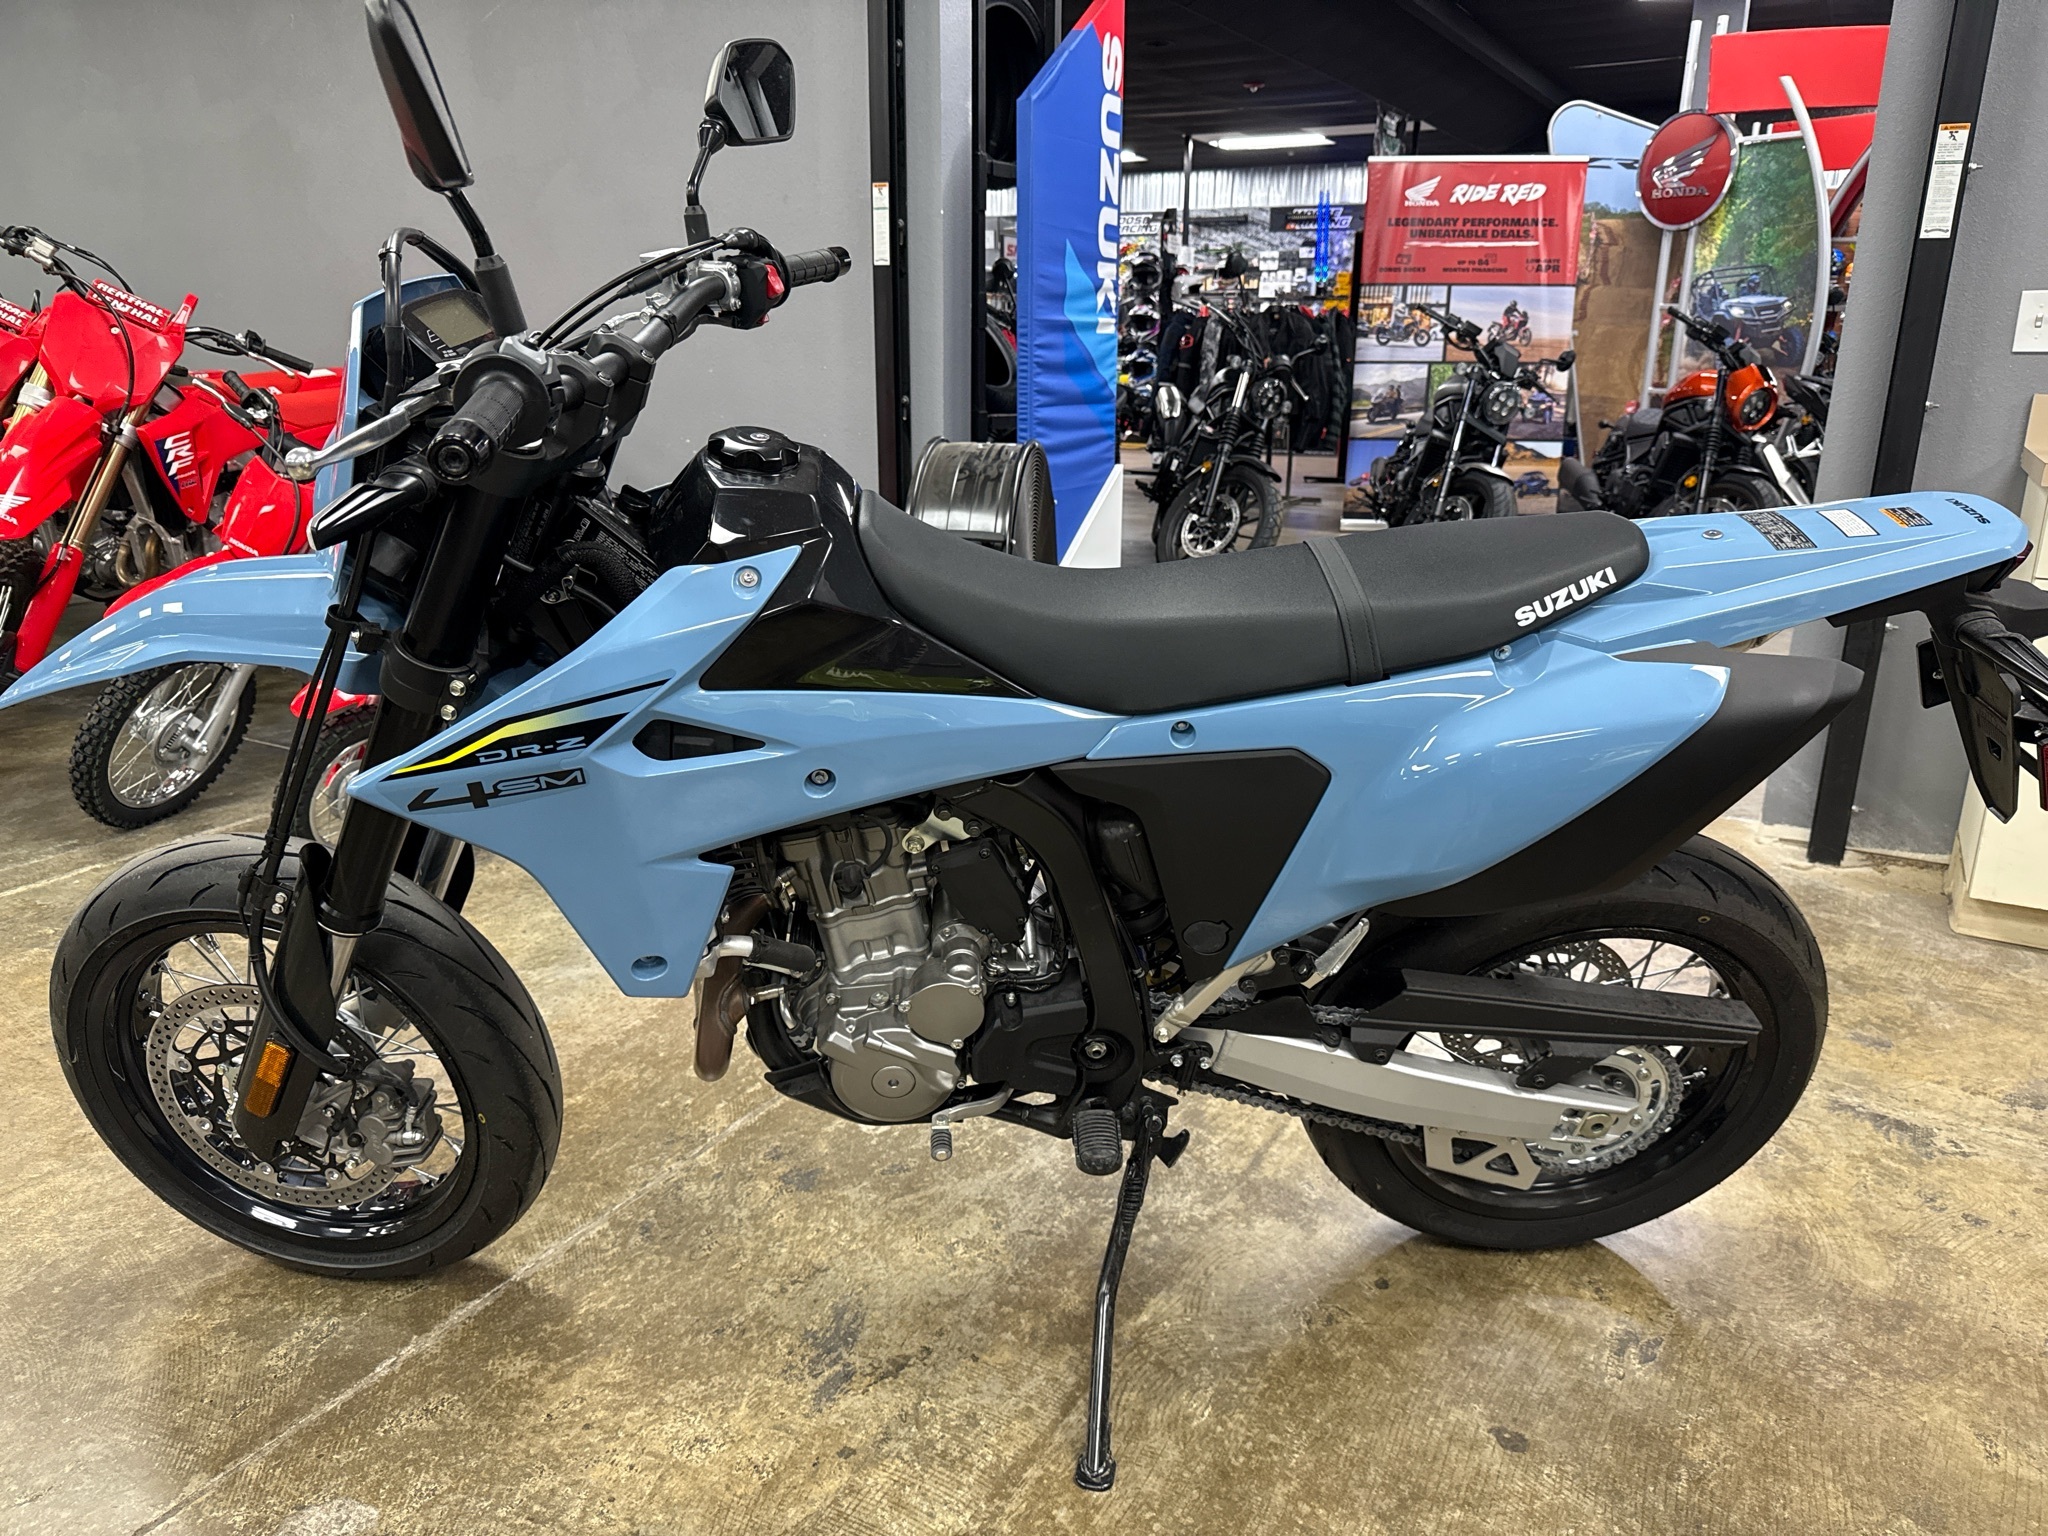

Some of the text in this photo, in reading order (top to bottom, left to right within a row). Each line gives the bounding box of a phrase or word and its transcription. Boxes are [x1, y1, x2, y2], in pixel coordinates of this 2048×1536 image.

[1096, 31, 1123, 335] SUZUKI
[1449, 182, 1547, 206] RIDE RED
[1651, 186, 1710, 199] HONDA
[1404, 199, 1440, 207] HONDA
[1387, 217, 1559, 227] LEGENDARY PERFORMANCE.
[1409, 229, 1534, 239] UNBEATABLE DEALS.
[1535, 264, 1560, 273] APR
[97, 282, 165, 318] RENTHAL
[163, 430, 195, 477] CRF
[1945, 498, 1991, 525] SUZUKI
[228, 536, 260, 557] HONDA
[1514, 566, 1618, 628] SUZUKI
[474, 736, 587, 764] DR-Z
